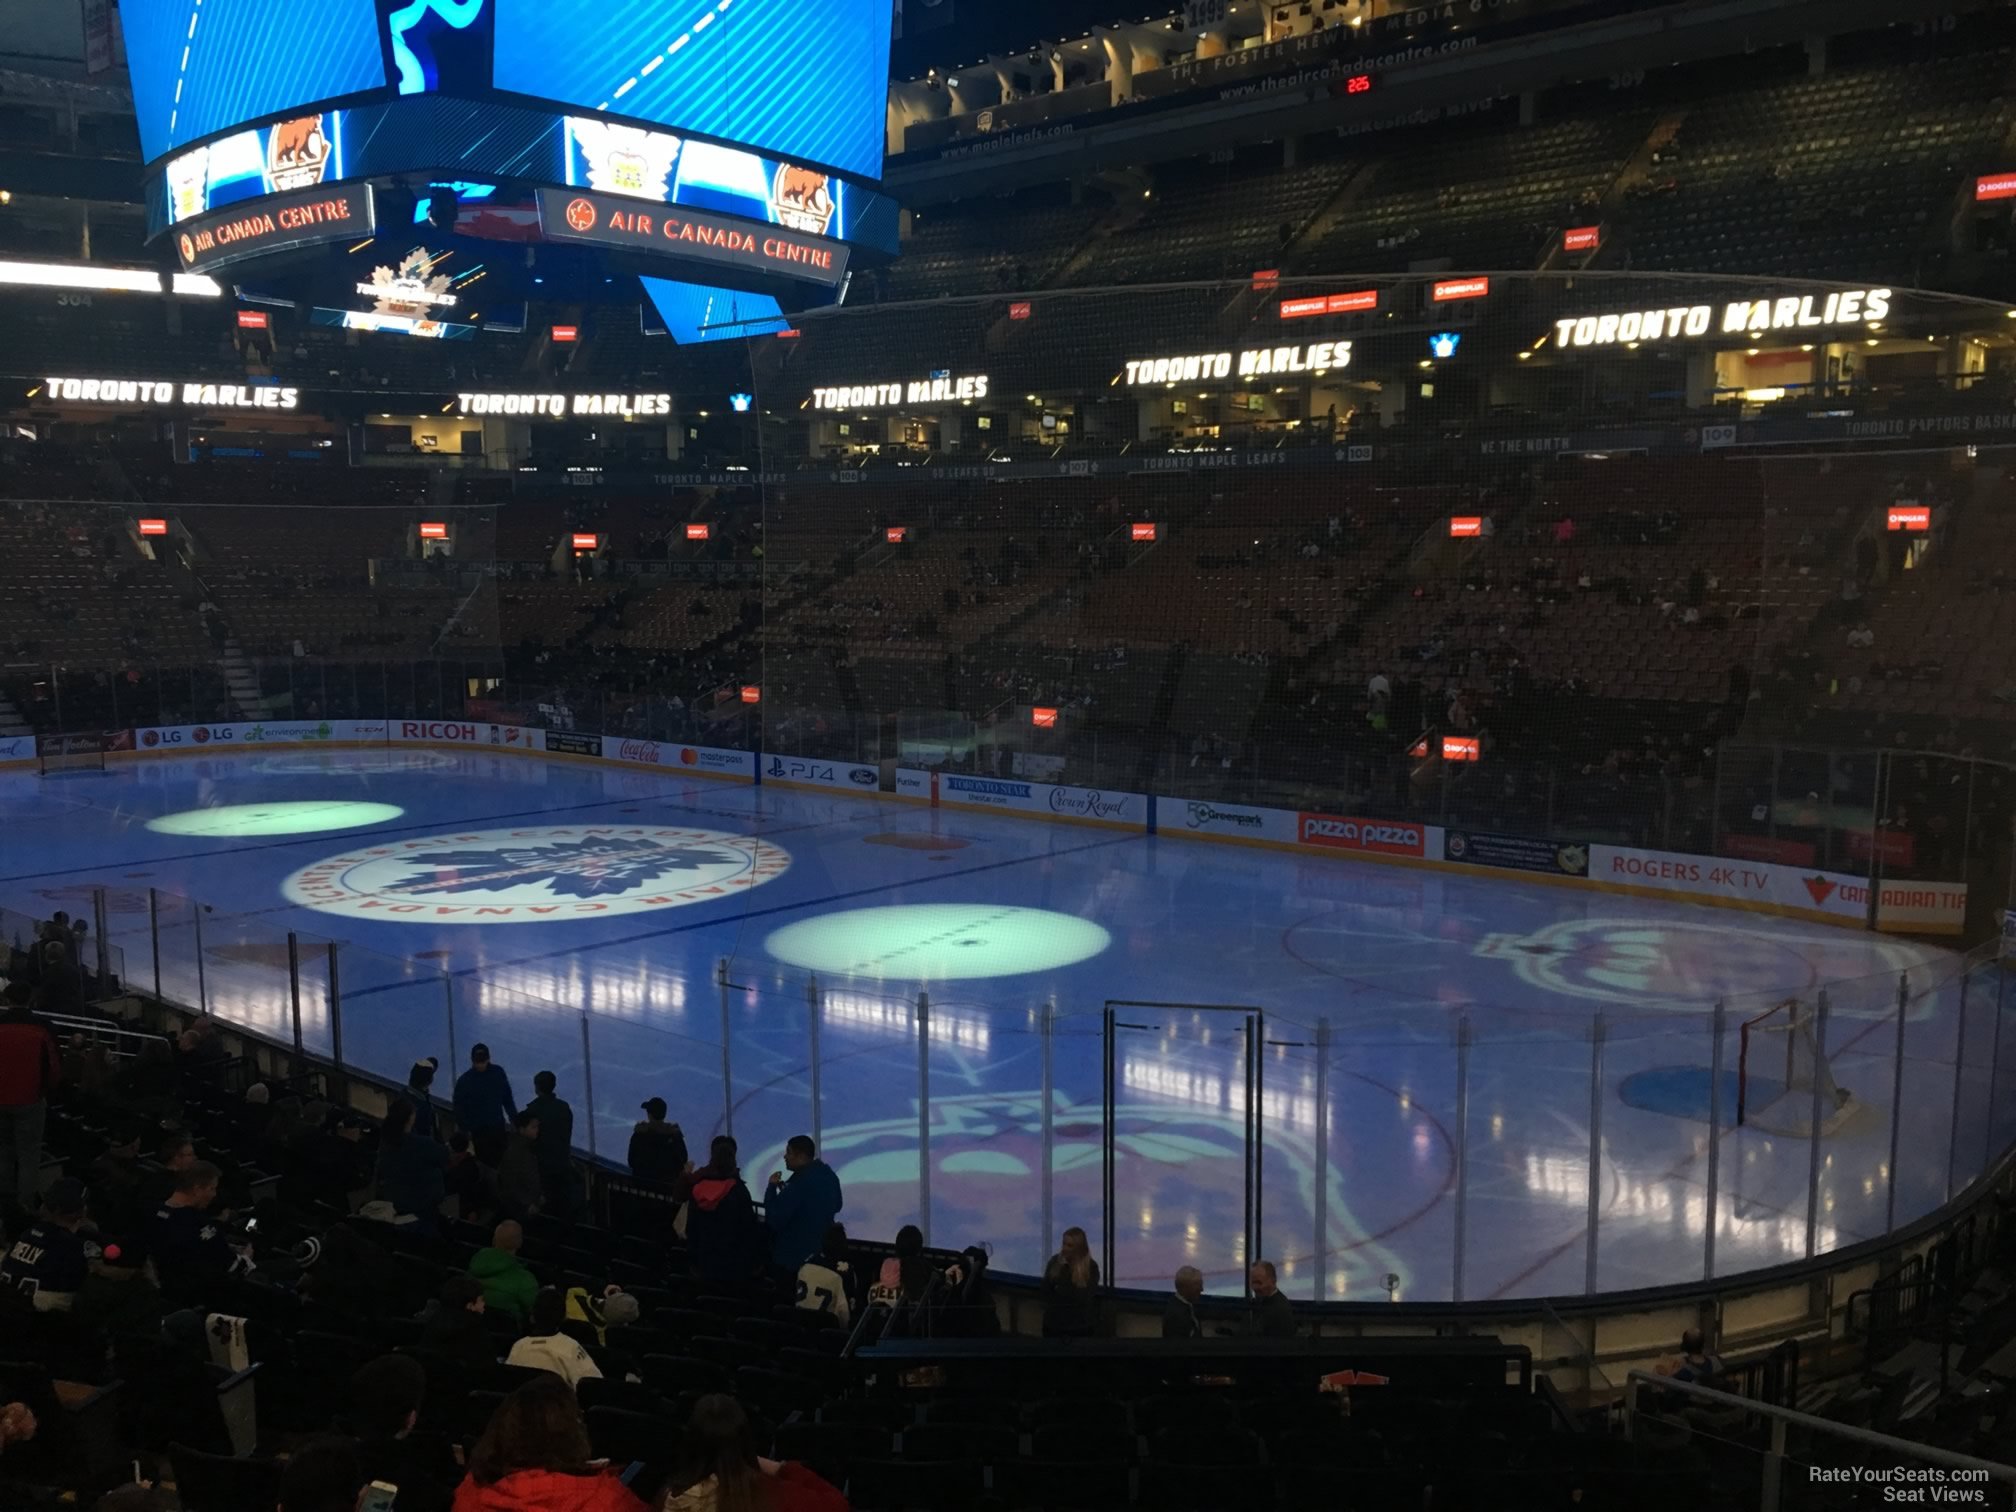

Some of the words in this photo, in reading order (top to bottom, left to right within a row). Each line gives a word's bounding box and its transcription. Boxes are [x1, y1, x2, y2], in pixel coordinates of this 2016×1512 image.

[1171, 62, 1202, 81] THE
[1214, 44, 1284, 71] FOSTER
[1387, 6, 1454, 31] MEDIA
[196, 230, 215, 252] AIR
[216, 213, 275, 244] CANADA
[279, 199, 350, 230] CENTRE
[609, 209, 652, 235] AIR
[664, 219, 755, 253] CANADA
[763, 238, 832, 269] CENTRE
[1555, 305, 1711, 348] TORONTO
[1722, 289, 1892, 333] MARLIES
[1126, 353, 1231, 385] TORONTO
[1239, 341, 1352, 375] MARLIES
[47, 378, 172, 401] TORONTO
[182, 384, 297, 408] MARLIES
[813, 383, 901, 409] TORONTO
[907, 376, 989, 403] MARLIES
[458, 393, 565, 415] TORONTO
[573, 394, 671, 415] MARLIES
[1703, 429, 1733, 442] 109
[1845, 420, 1904, 435] TORONTO
[1480, 441, 1496, 454] WE
[1500, 439, 1522, 452] THE
[1527, 437, 1570, 451] NORTH
[1071, 461, 1087, 472] 107
[1143, 455, 1193, 469] TORONTO
[1199, 454, 1237, 468] MAPLE
[1247, 452, 1286, 465] LEAFS
[654, 474, 702, 484] TORONTO
[709, 473, 745, 484] MAPLE
[752, 473, 786, 484] LEAFS
[841, 471, 857, 481] 106
[949, 468, 978, 478] LEAFS
[1898, 514, 1927, 523] ROGERS
[162, 732, 182, 743] LG
[213, 728, 233, 740] LG
[402, 722, 476, 741] RICOH
[700, 752, 744, 765] masterpass
[791, 763, 835, 781] PS4
[897, 777, 921, 788] Further
[952, 778, 999, 793] TORONTO
[1000, 784, 1026, 796] STAR
[1049, 786, 1086, 812] Crown
[1081, 789, 1129, 818] Royal
[1208, 809, 1263, 826] Greenpark
[510, 827, 708, 841] CANADA
[1304, 818, 1358, 840] pizza
[1361, 824, 1420, 846] pizza
[1612, 856, 1700, 881] ROGERS
[1708, 868, 1735, 887] 4K
[1740, 871, 1769, 890] TV
